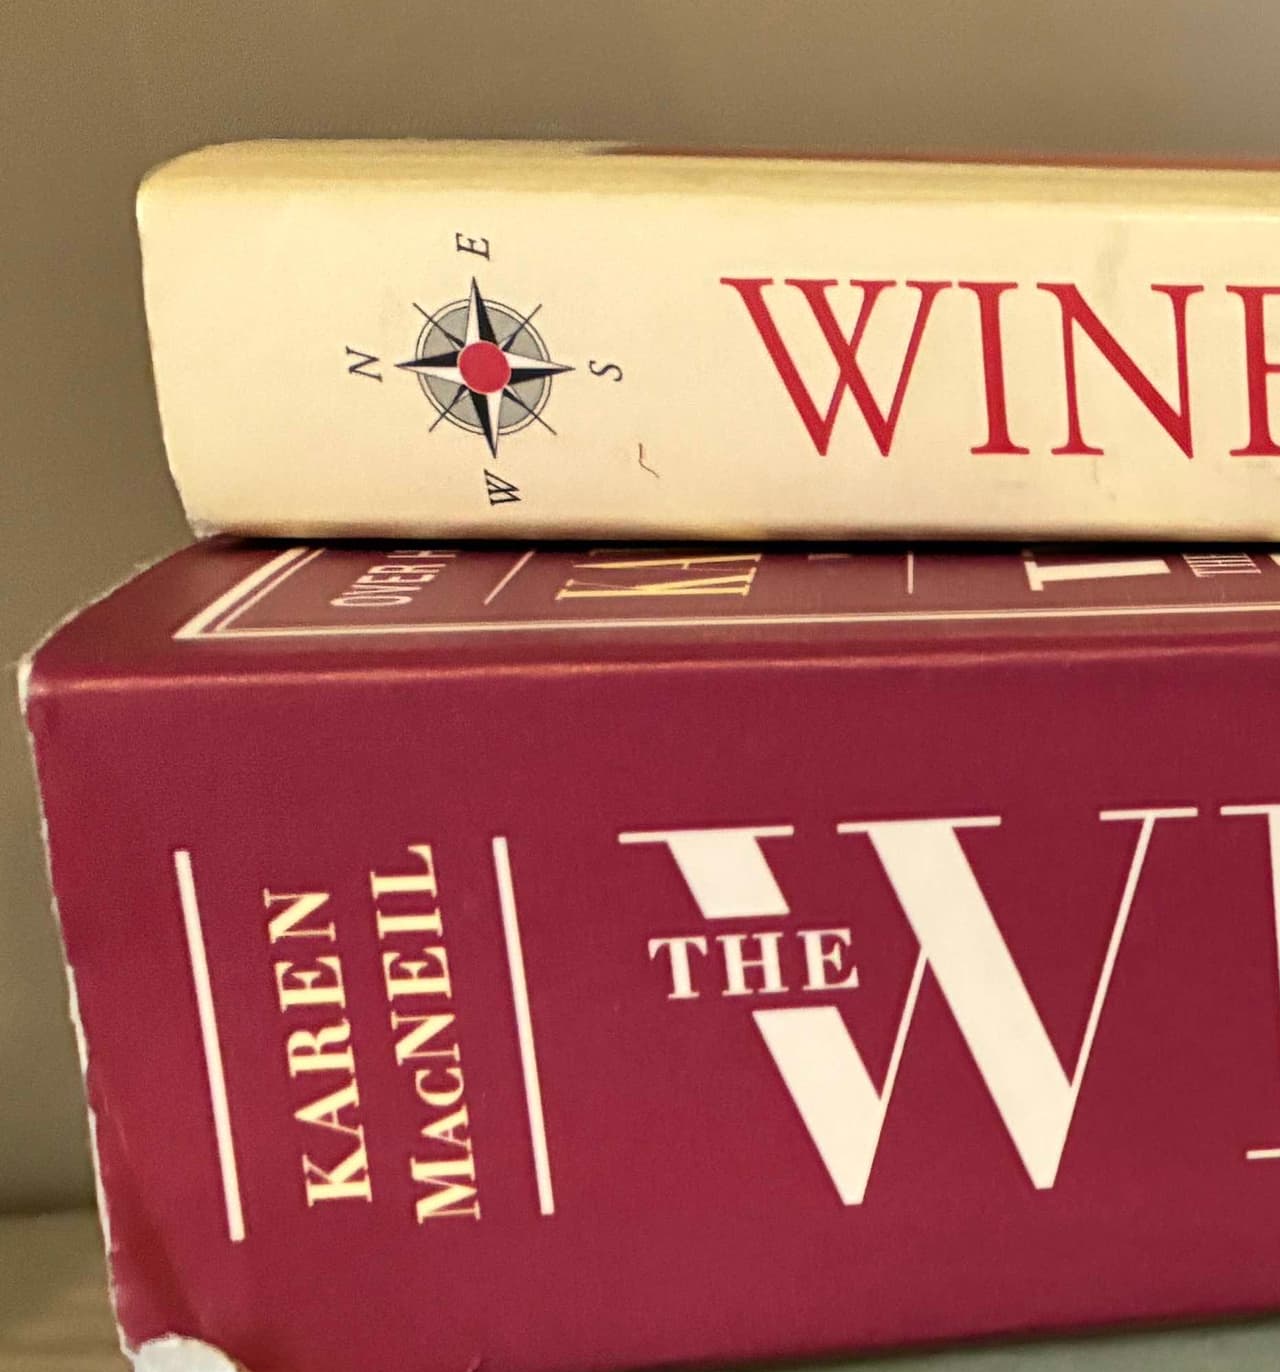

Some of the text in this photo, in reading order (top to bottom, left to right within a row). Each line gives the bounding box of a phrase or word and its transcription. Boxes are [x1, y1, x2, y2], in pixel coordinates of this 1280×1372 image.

[457, 233, 491, 259] E
[347, 348, 384, 382] N
[590, 359, 622, 382] S
[485, 471, 522, 506] W
[329, 563, 446, 607] OVER
[647, 926, 861, 1000] THE
[264, 887, 375, 1208] KAREN
